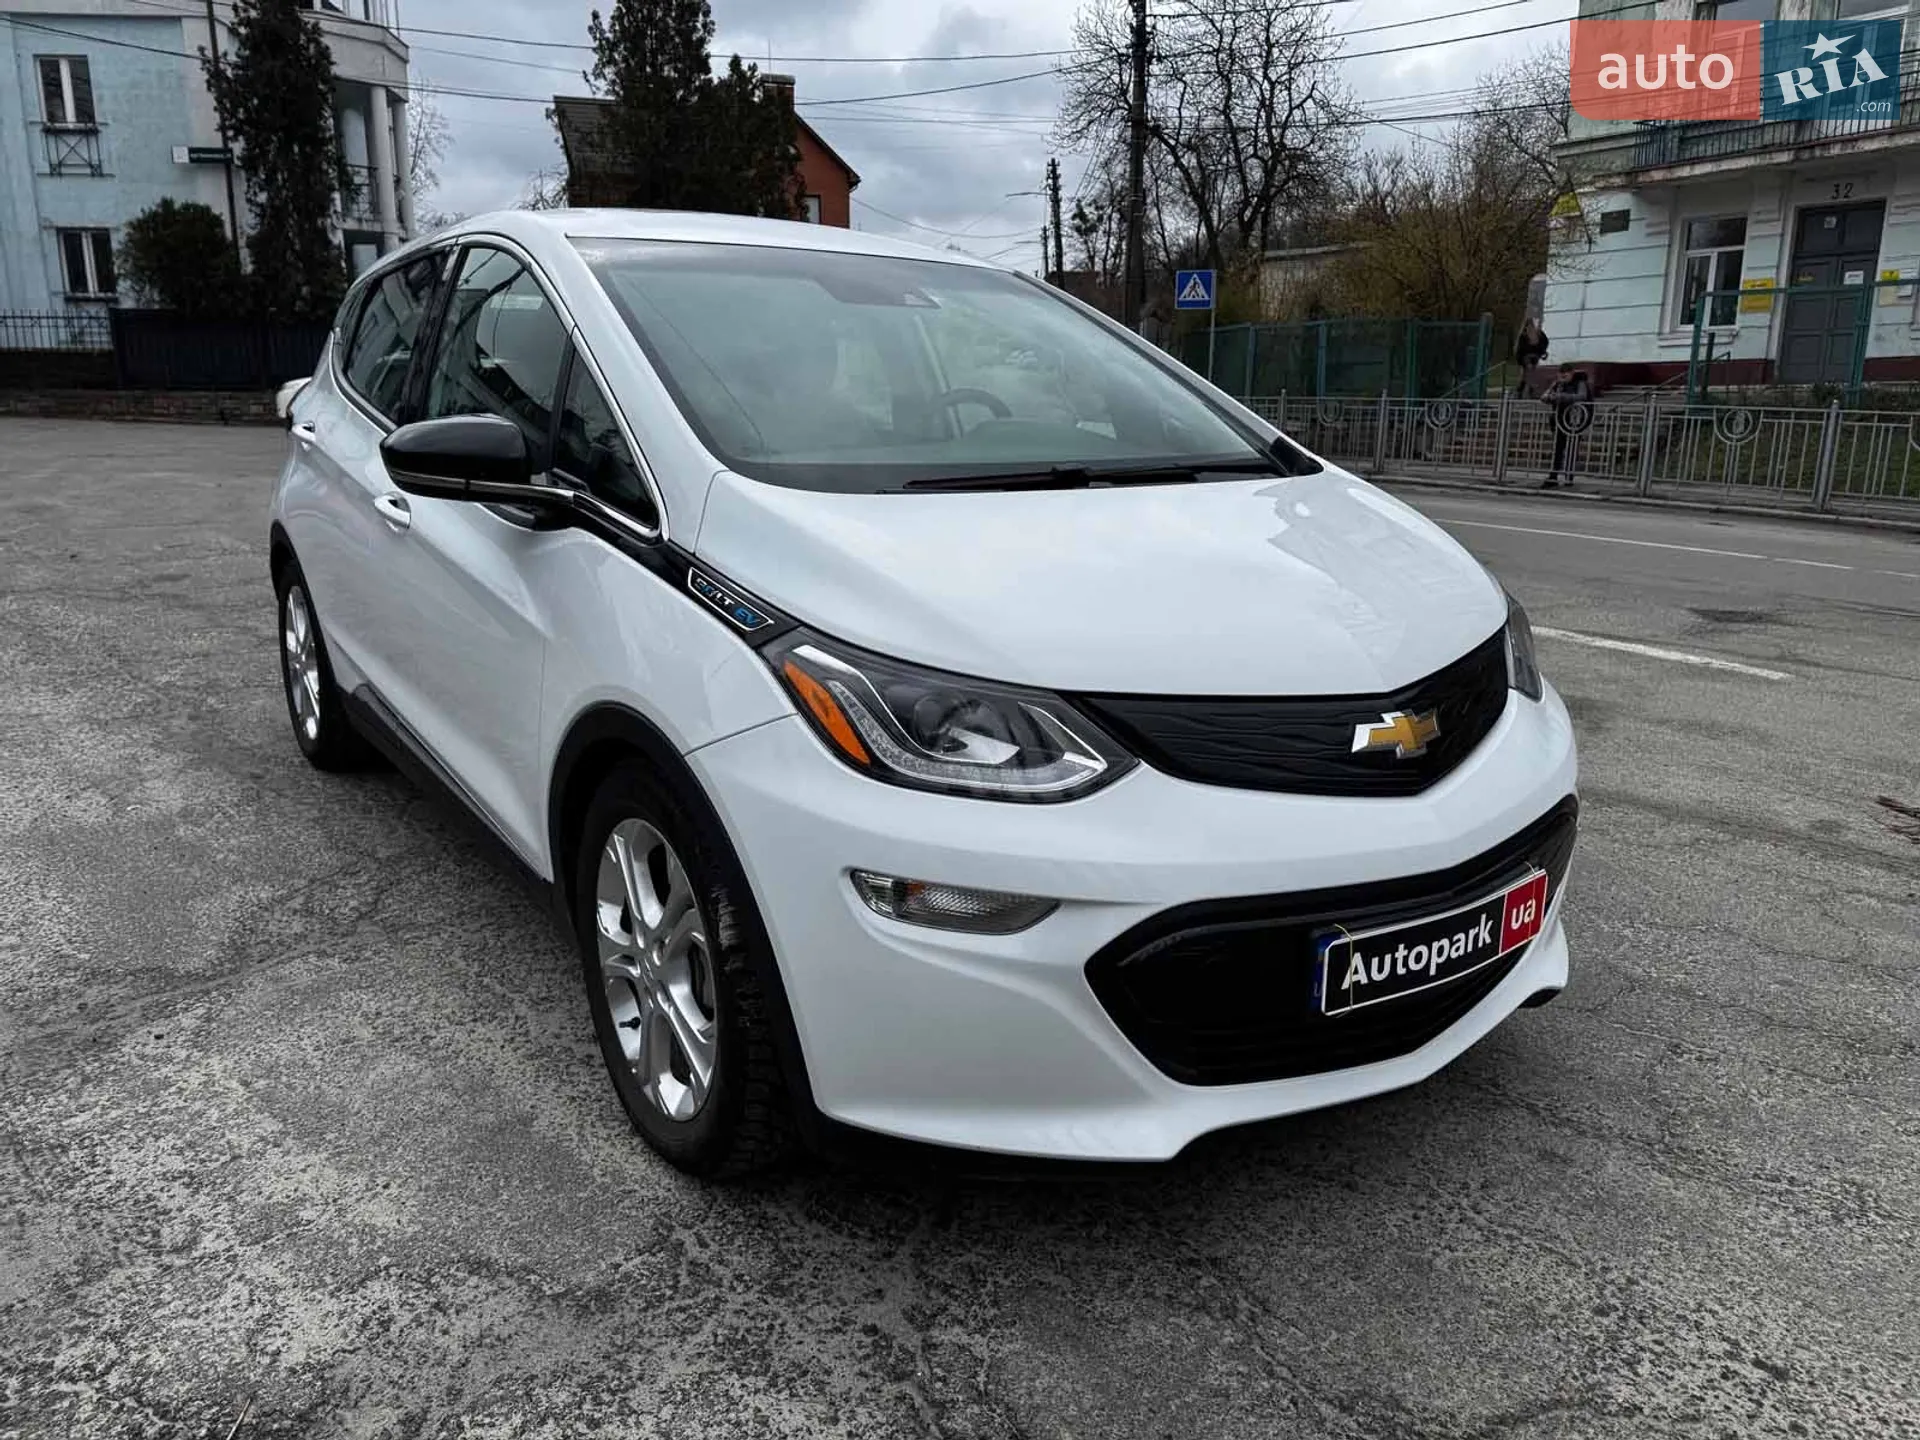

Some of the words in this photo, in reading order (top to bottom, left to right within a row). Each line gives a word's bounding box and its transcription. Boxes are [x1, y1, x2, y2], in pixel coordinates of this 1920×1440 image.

[1832, 182, 1854, 200] 32
[1341, 912, 1494, 991] Autopark
[1510, 898, 1536, 930] ua
